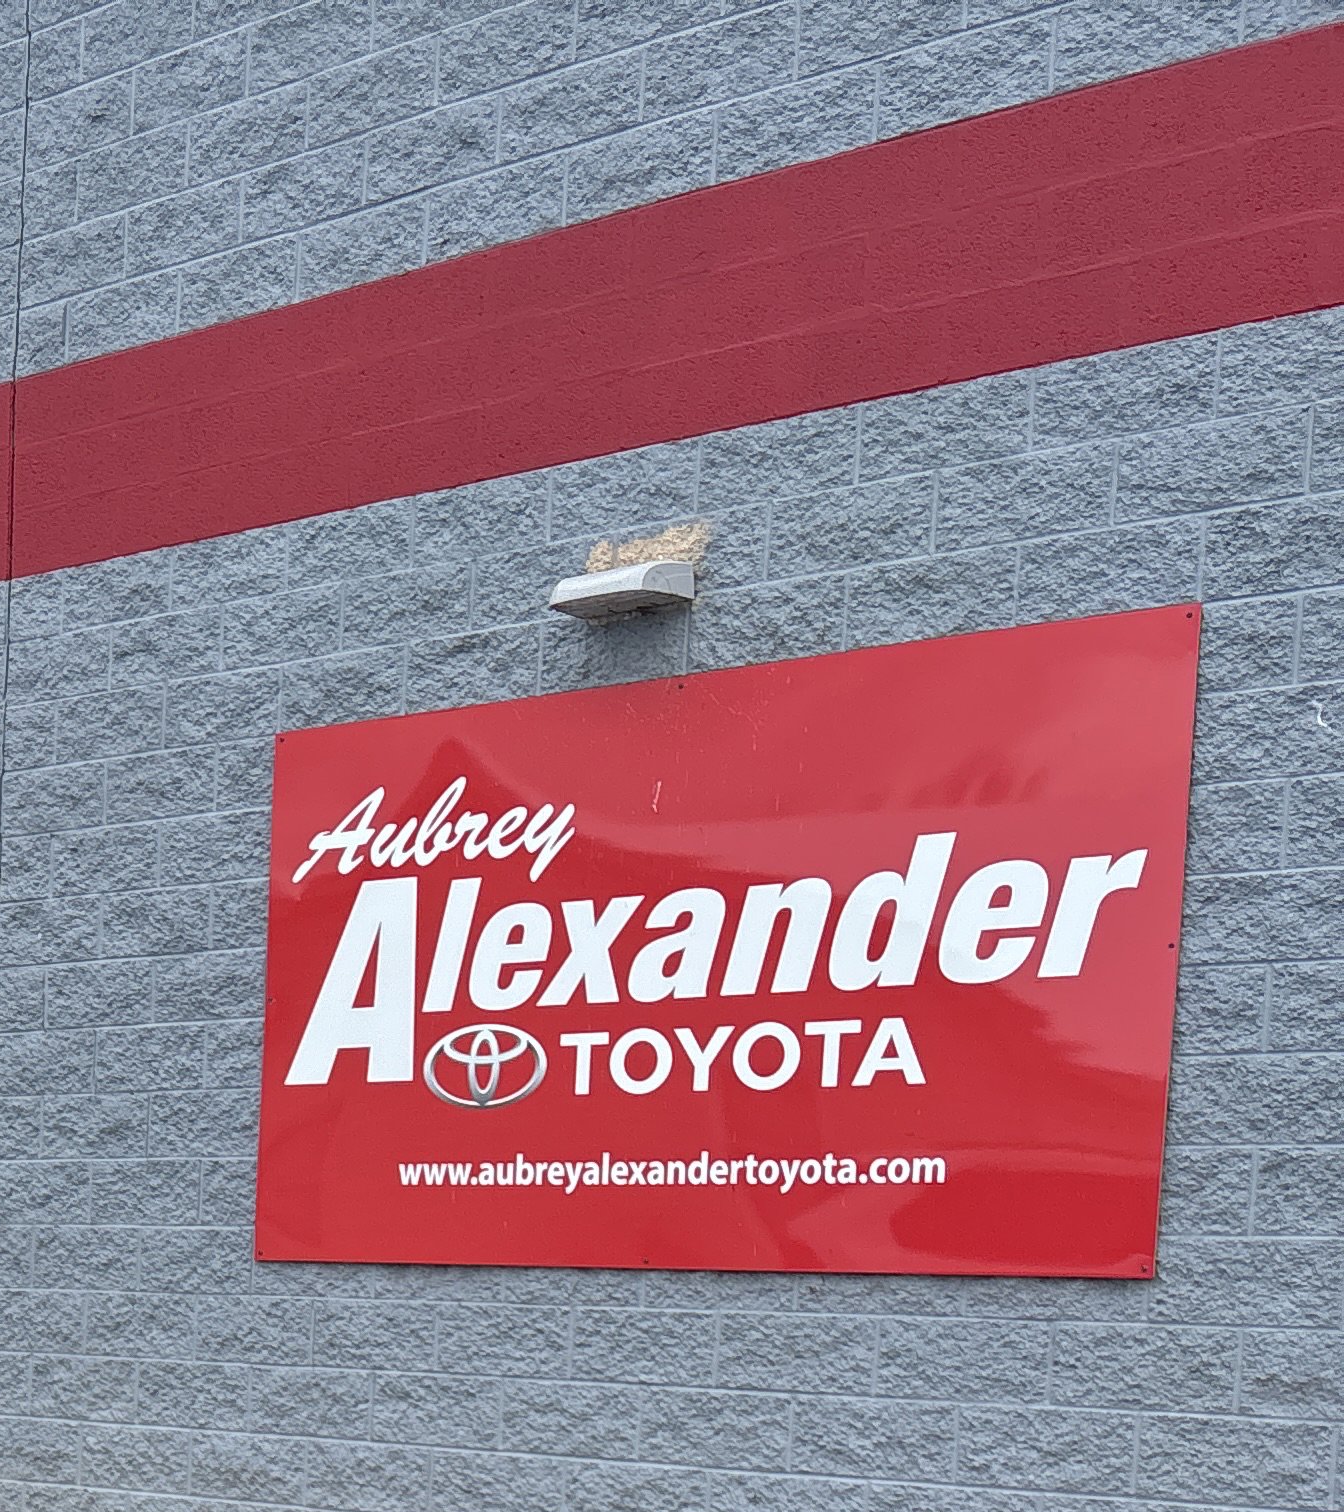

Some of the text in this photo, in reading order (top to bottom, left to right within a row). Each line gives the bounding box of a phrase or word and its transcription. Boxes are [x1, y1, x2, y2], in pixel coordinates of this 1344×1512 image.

[292, 776, 575, 884] Aubrey
[284, 831, 1148, 1086] Alexander
[559, 1017, 926, 1096] TOYOTA
[398, 1150, 946, 1194] www.aubreyalexandertoyota.com
